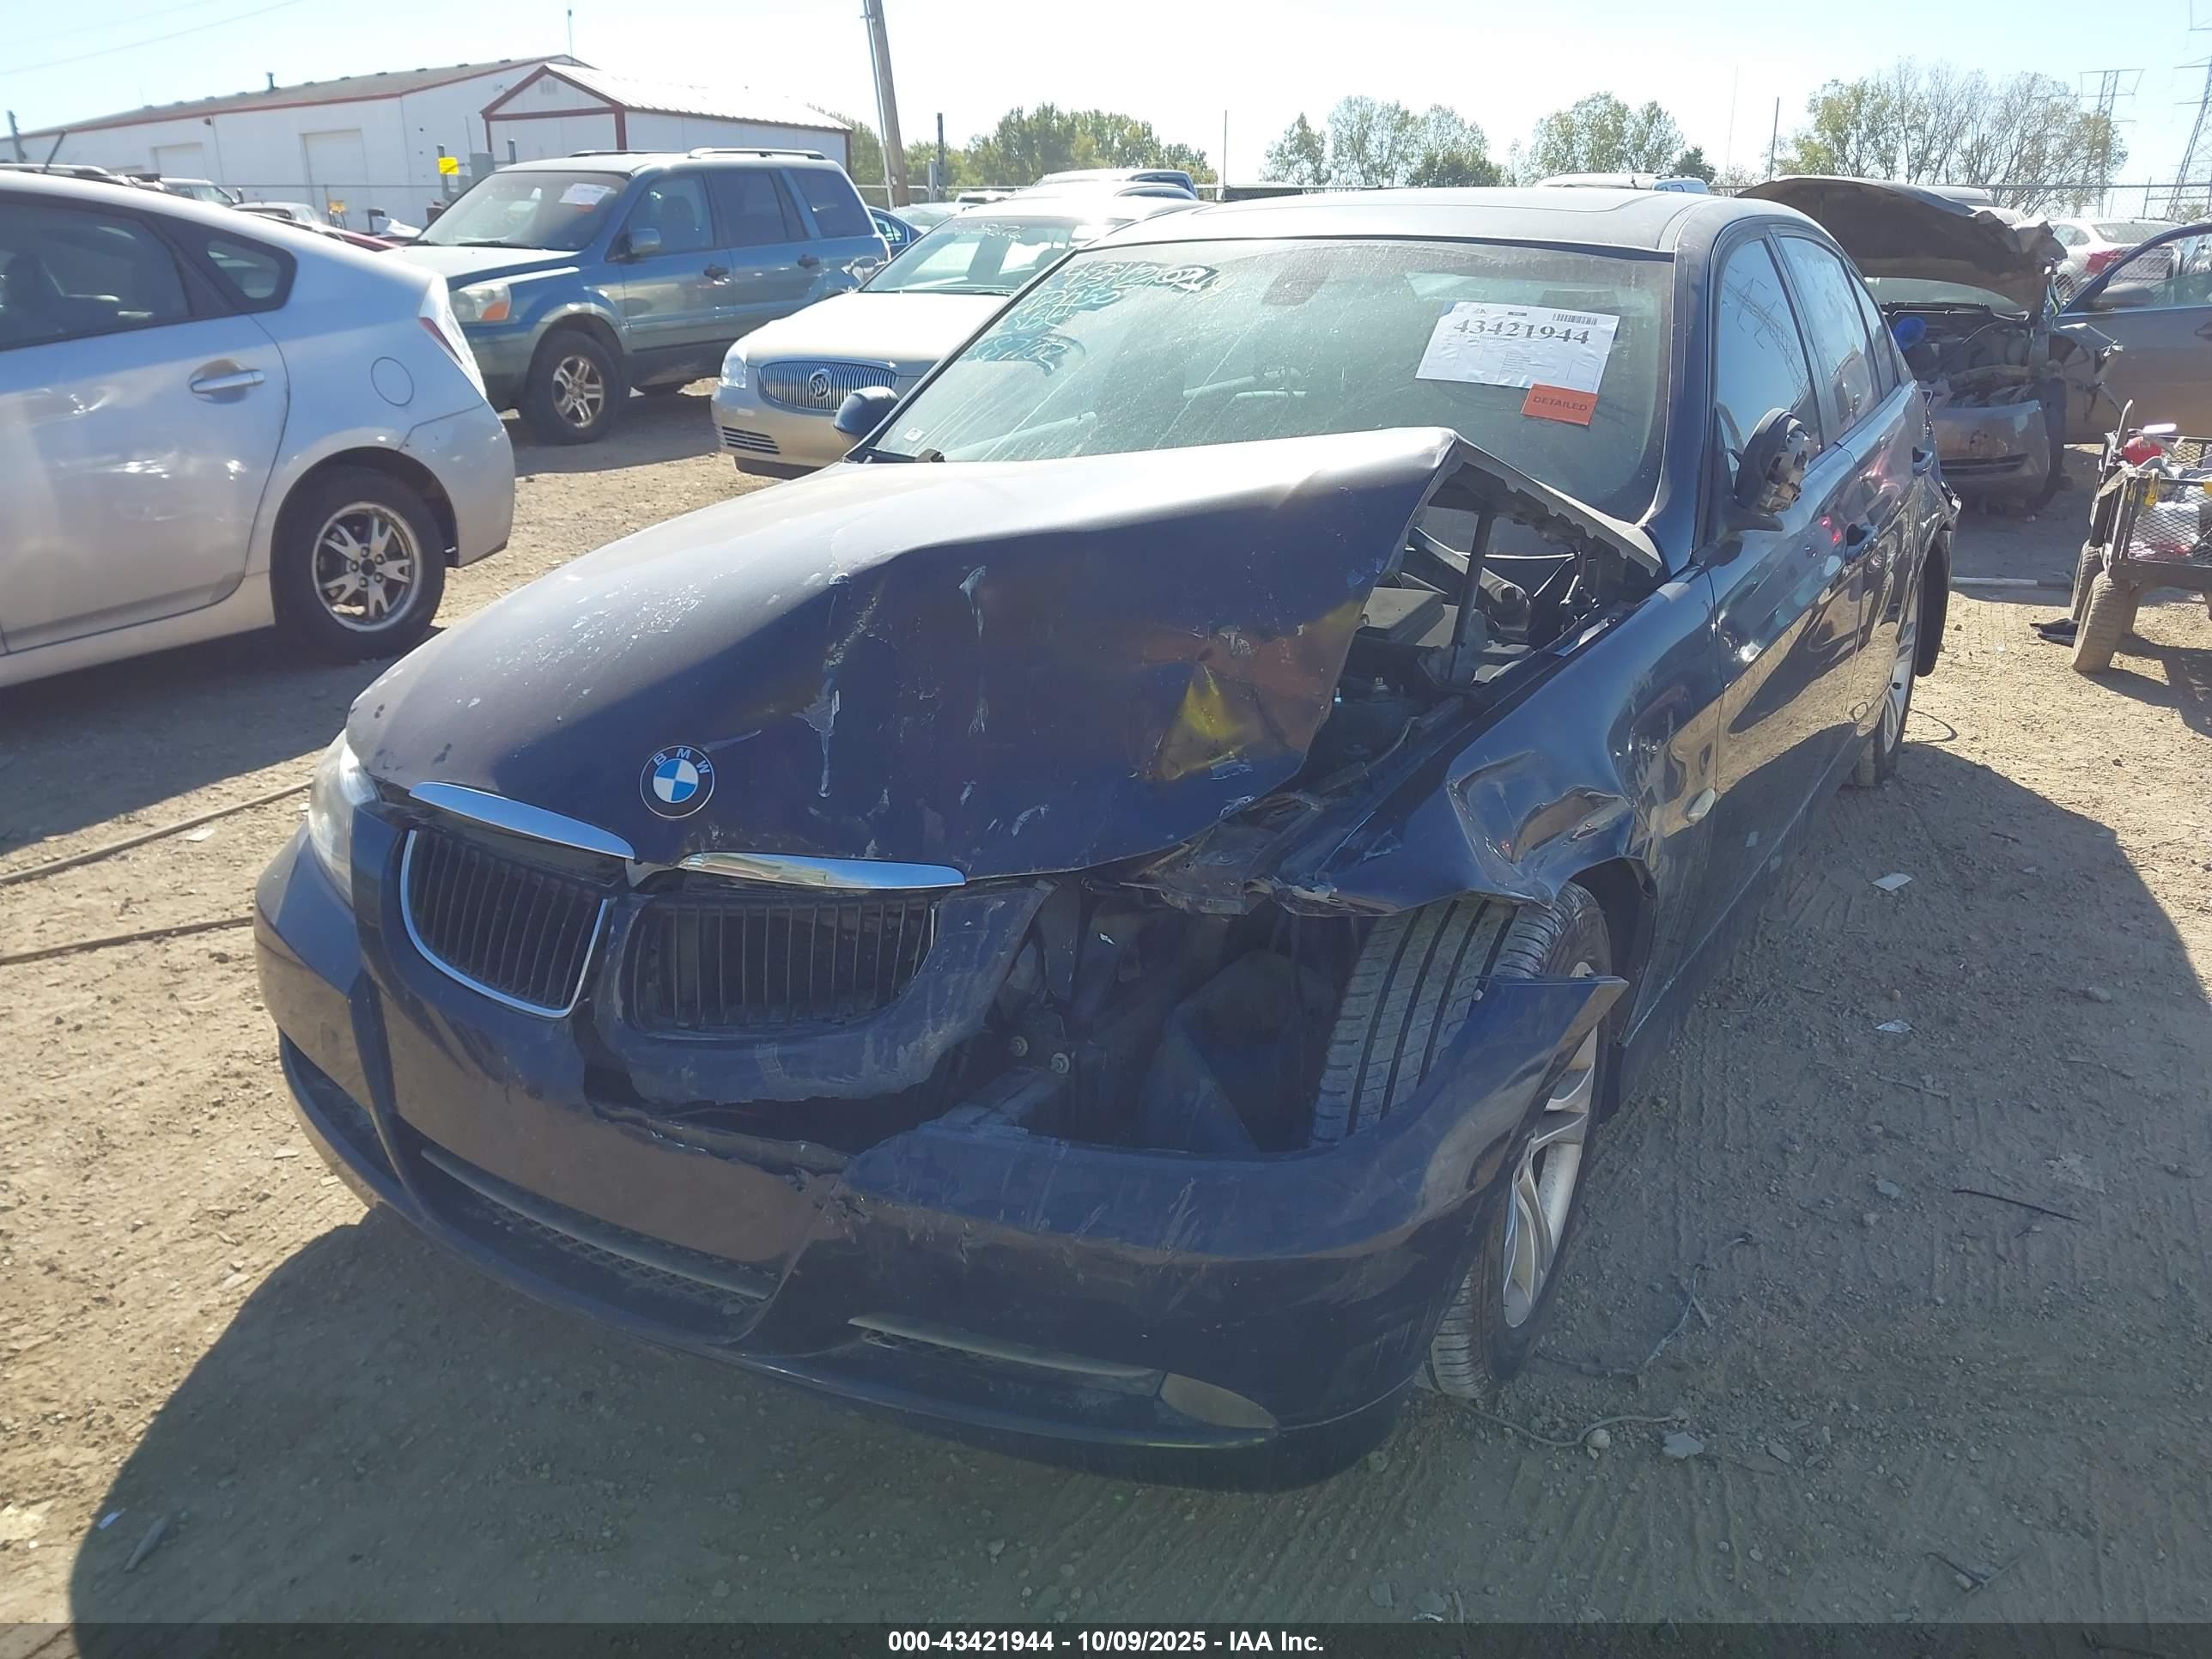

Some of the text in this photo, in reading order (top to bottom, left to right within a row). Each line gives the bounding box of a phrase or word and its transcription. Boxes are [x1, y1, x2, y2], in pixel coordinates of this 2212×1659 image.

[1453, 319, 1590, 345] 43421944
[1533, 396, 1588, 411] DETAILED
[653, 747, 710, 774] BMW
